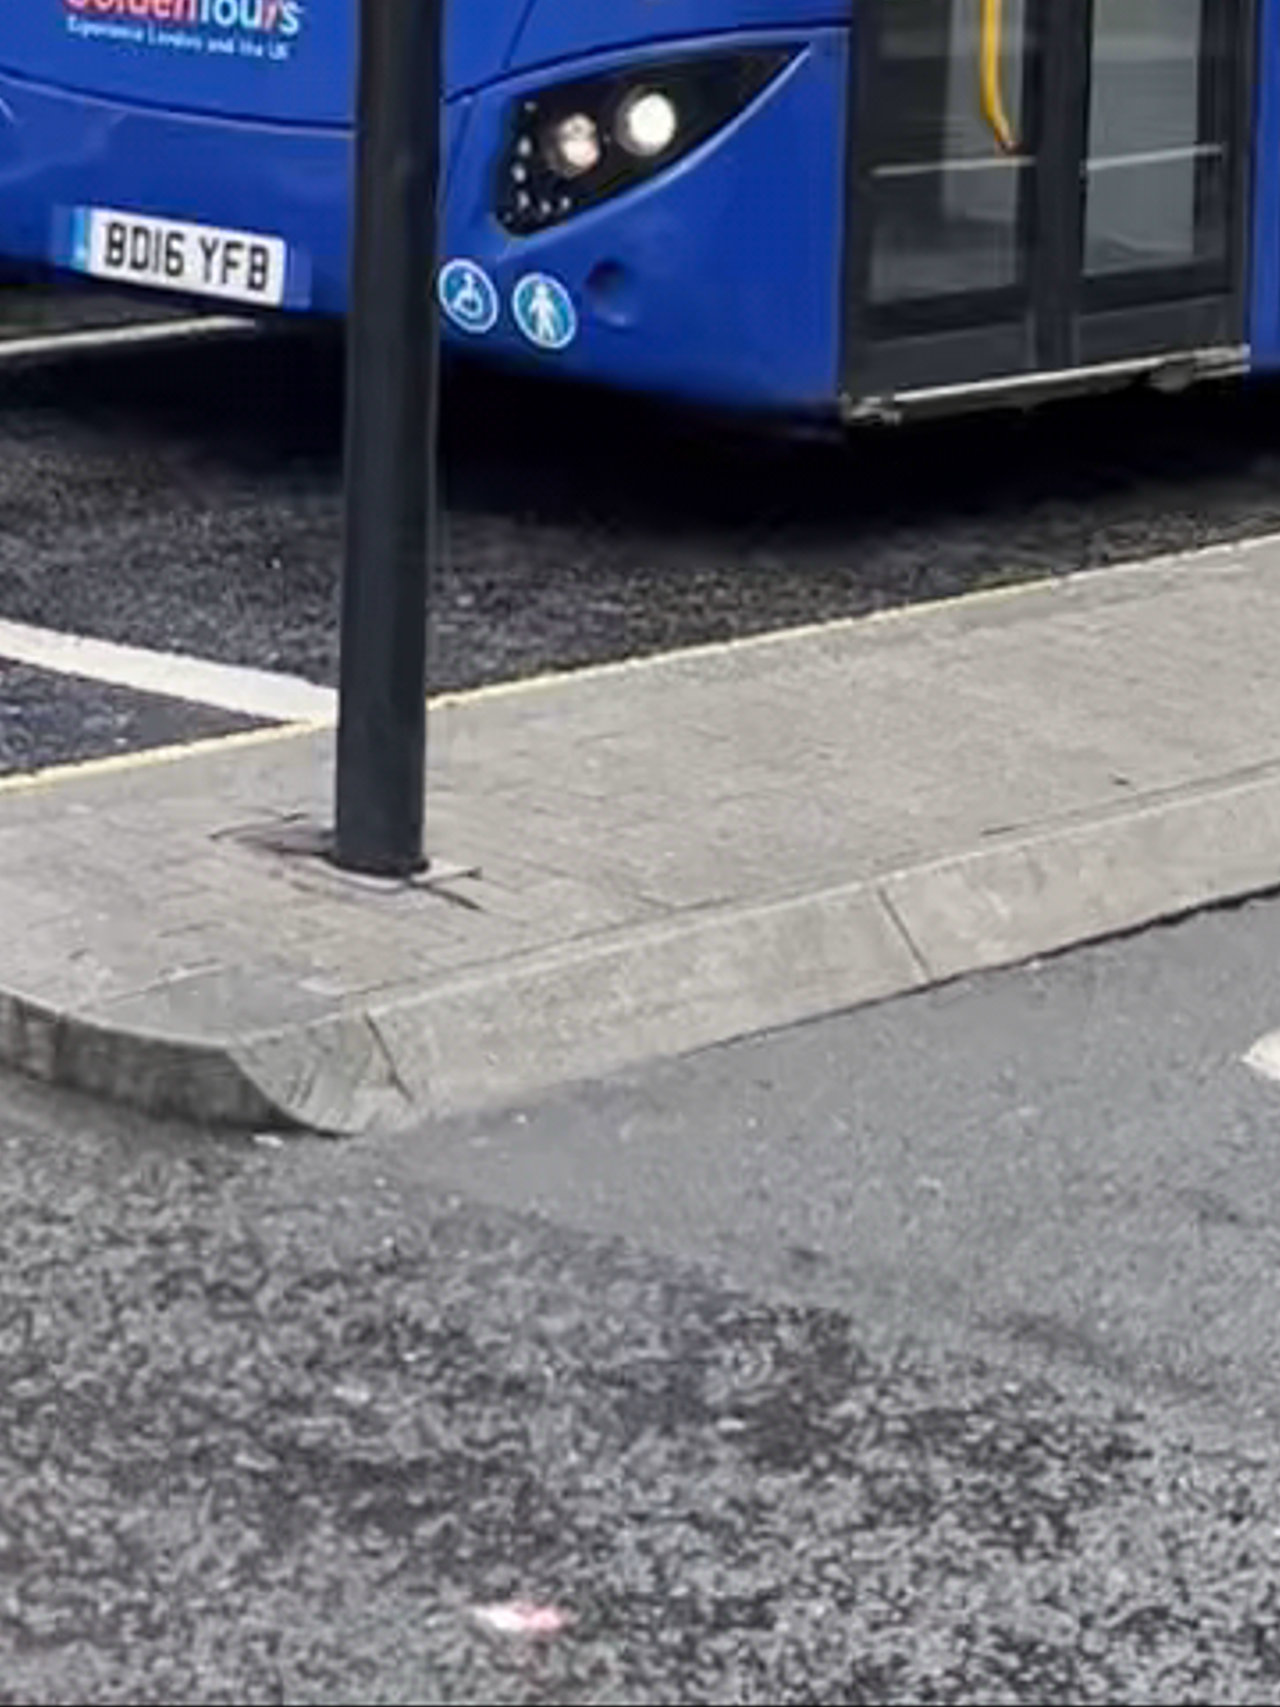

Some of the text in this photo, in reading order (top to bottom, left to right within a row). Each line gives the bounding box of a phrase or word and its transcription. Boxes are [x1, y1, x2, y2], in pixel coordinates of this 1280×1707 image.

[207, 34, 235, 54] and
[105, 221, 270, 292] BD16 YFB
